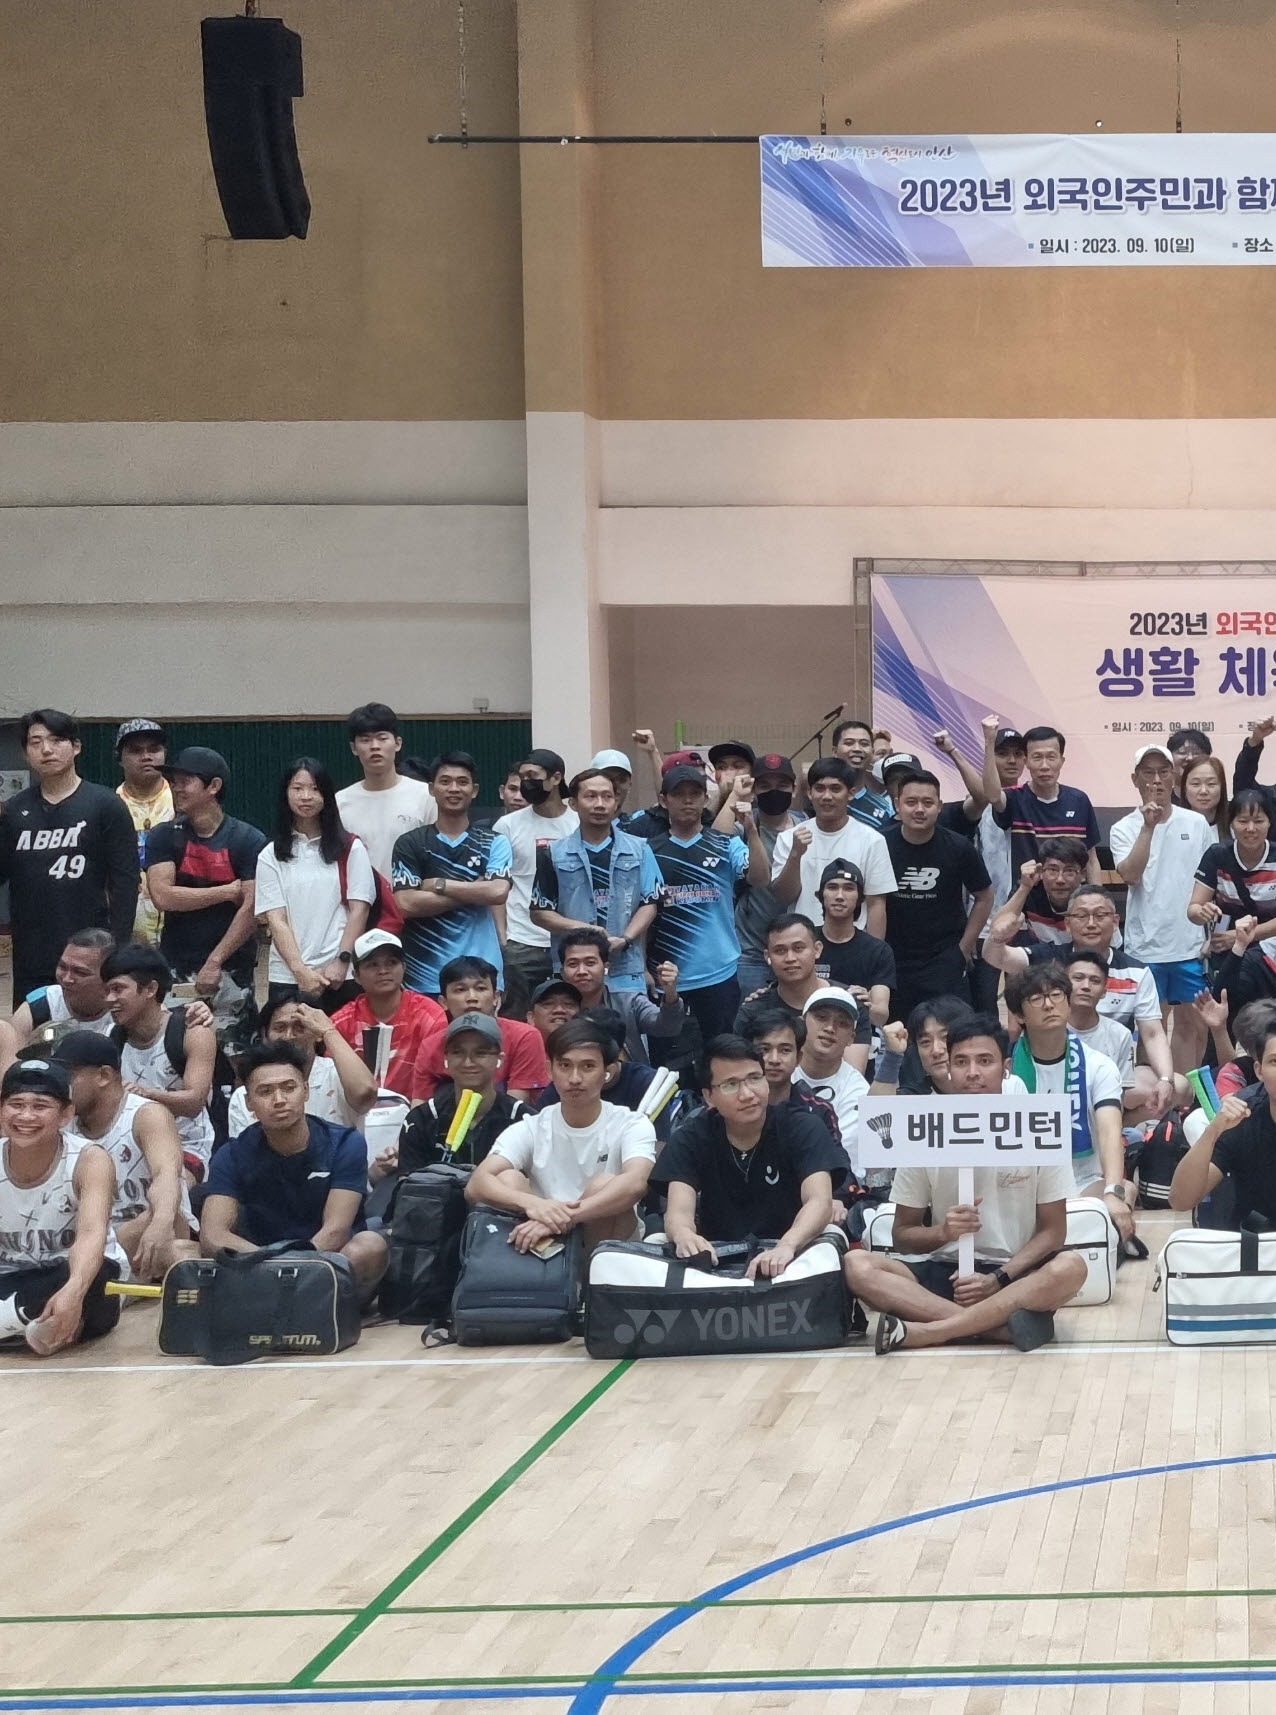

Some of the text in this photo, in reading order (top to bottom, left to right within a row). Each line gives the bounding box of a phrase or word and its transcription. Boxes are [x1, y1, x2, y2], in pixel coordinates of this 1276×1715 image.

[925, 146, 957, 160] 안산
[899, 177, 1013, 212] 2023년
[1023, 176, 1227, 213] 외국인주민과
[1039, 238, 1069, 254] 일시
[1082, 238, 1121, 254] 2023.
[1126, 238, 1148, 254] 09.
[1154, 237, 1195, 254] 10(일)
[1243, 237, 1274, 253] 장소
[1129, 612, 1208, 636] 2023년
[1096, 646, 1200, 697] 생활
[1111, 721, 1132, 733] 일시
[1139, 721, 1166, 732] 2023.
[16, 821, 87, 851] ABBA
[48, 854, 87, 880] 49
[907, 1110, 1063, 1151] 배드민턴
[690, 1297, 814, 1341] YONEX
